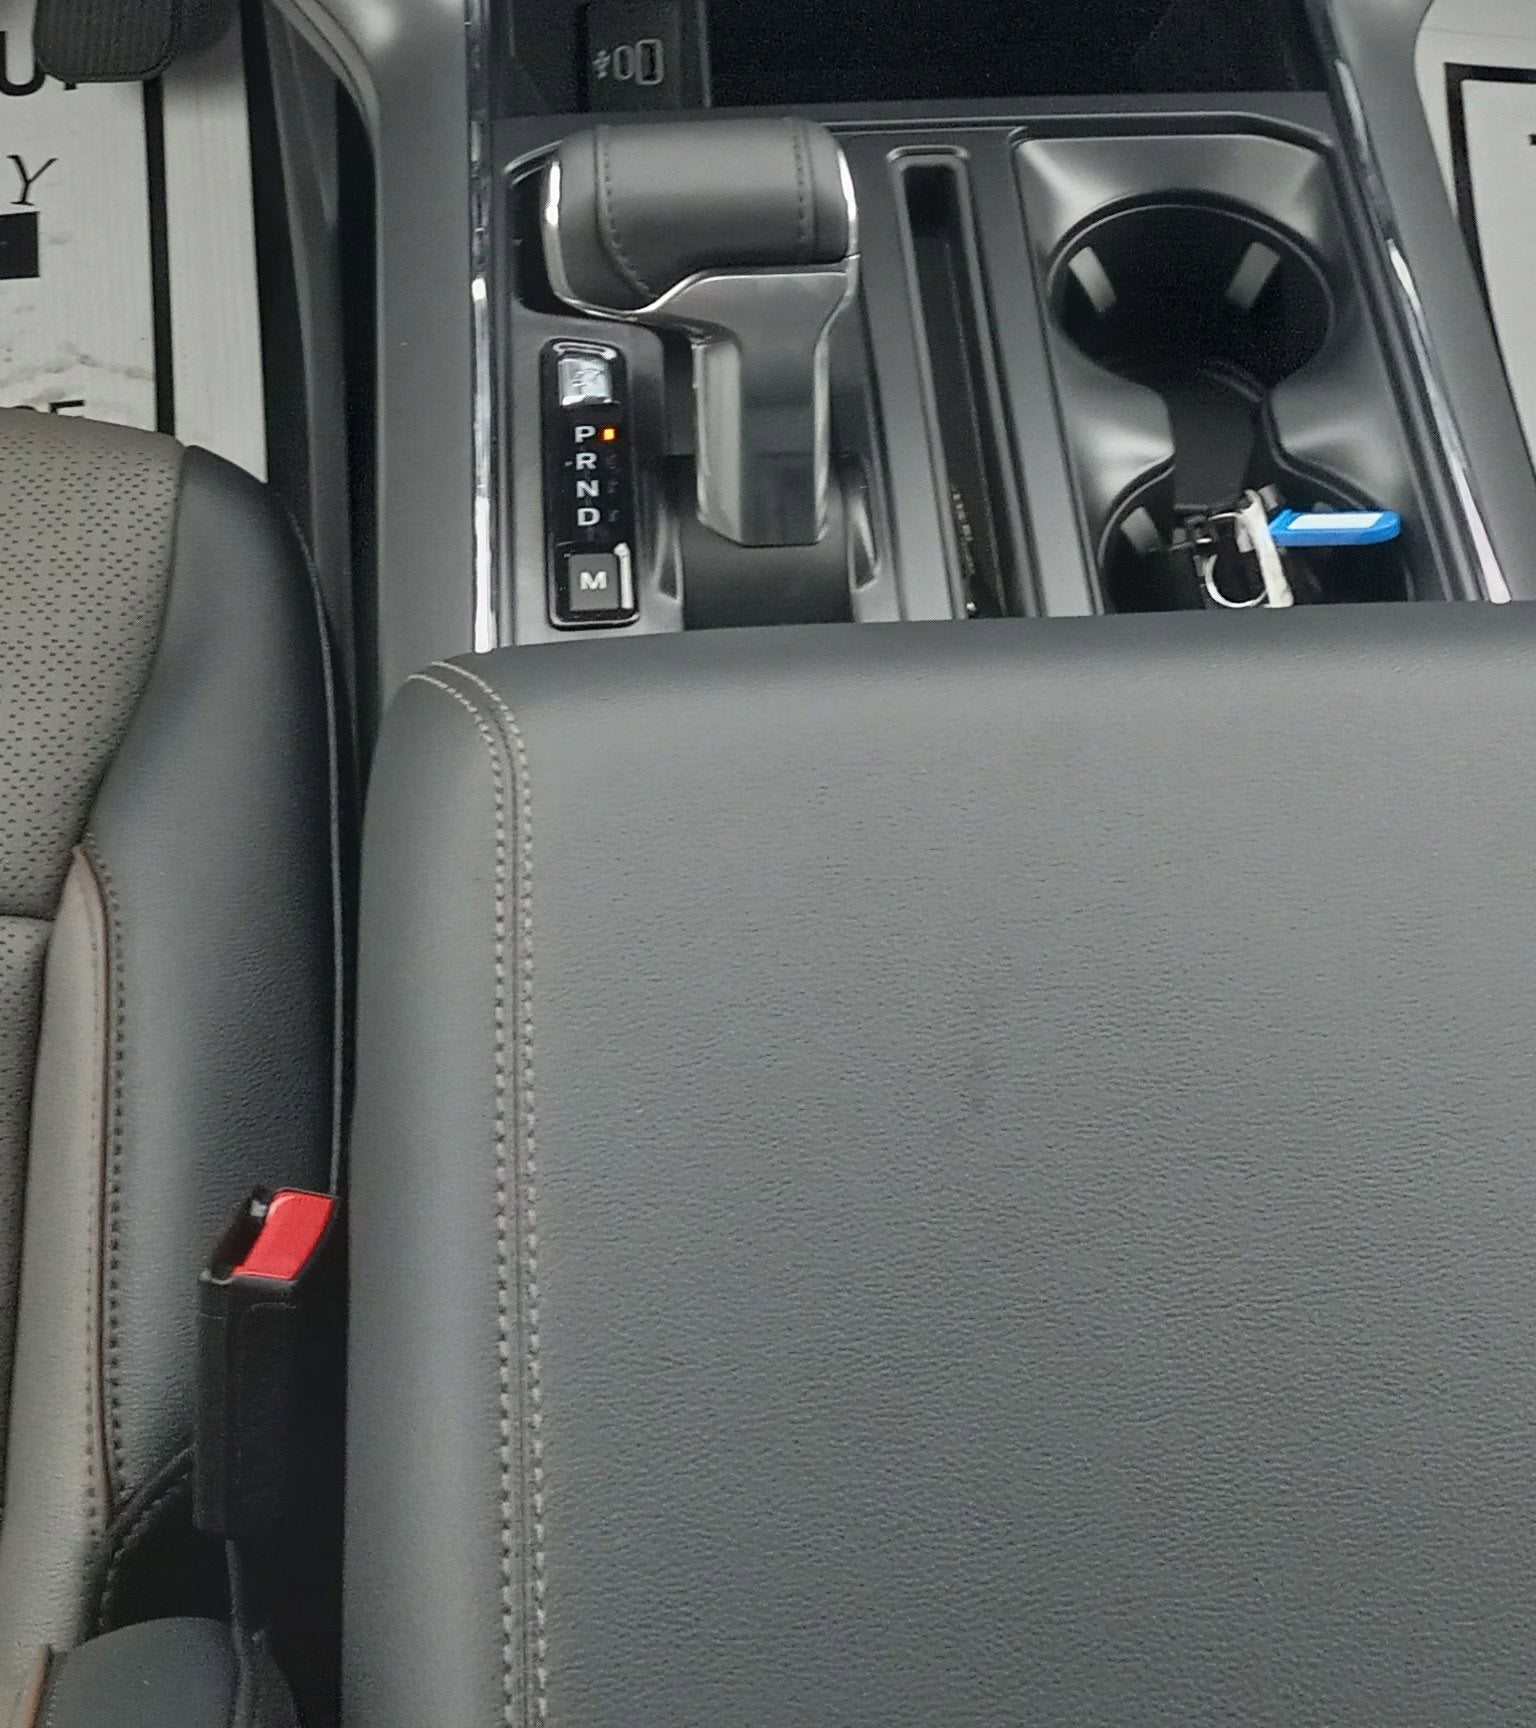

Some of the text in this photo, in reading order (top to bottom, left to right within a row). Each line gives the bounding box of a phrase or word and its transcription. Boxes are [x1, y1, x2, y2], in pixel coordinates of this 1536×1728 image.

[574, 425, 597, 443] P
[575, 452, 598, 470] R
[576, 479, 600, 498] N
[577, 507, 601, 527] D
[580, 571, 608, 590] M
